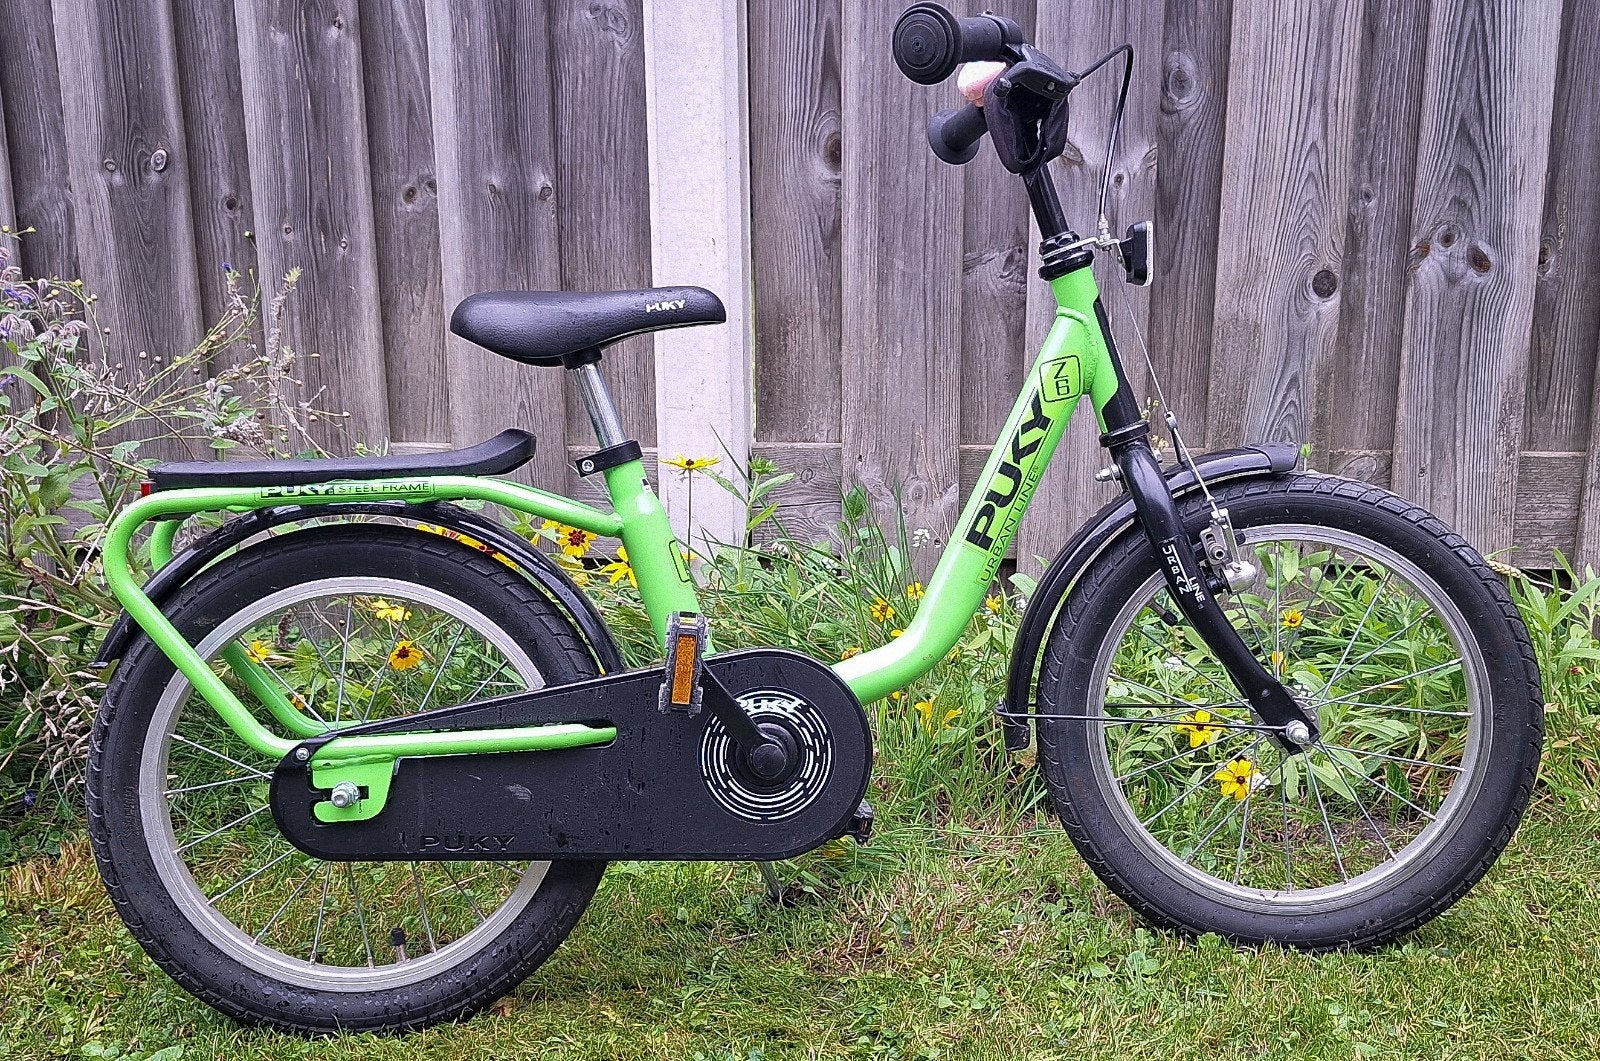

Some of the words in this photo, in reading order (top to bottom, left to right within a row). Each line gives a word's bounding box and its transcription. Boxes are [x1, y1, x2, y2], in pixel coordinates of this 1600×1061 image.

[646, 300, 686, 313] PUKY
[965, 389, 1052, 551] PUKY
[261, 484, 329, 498] PUKY
[338, 484, 378, 494] STEEL
[382, 482, 429, 492] FRAME
[981, 517, 1017, 582] URBAN
[1014, 472, 1040, 513] LINE
[1162, 545, 1190, 595] URBAN
[1189, 576, 1206, 603] LINE
[420, 835, 515, 852] PUKY
